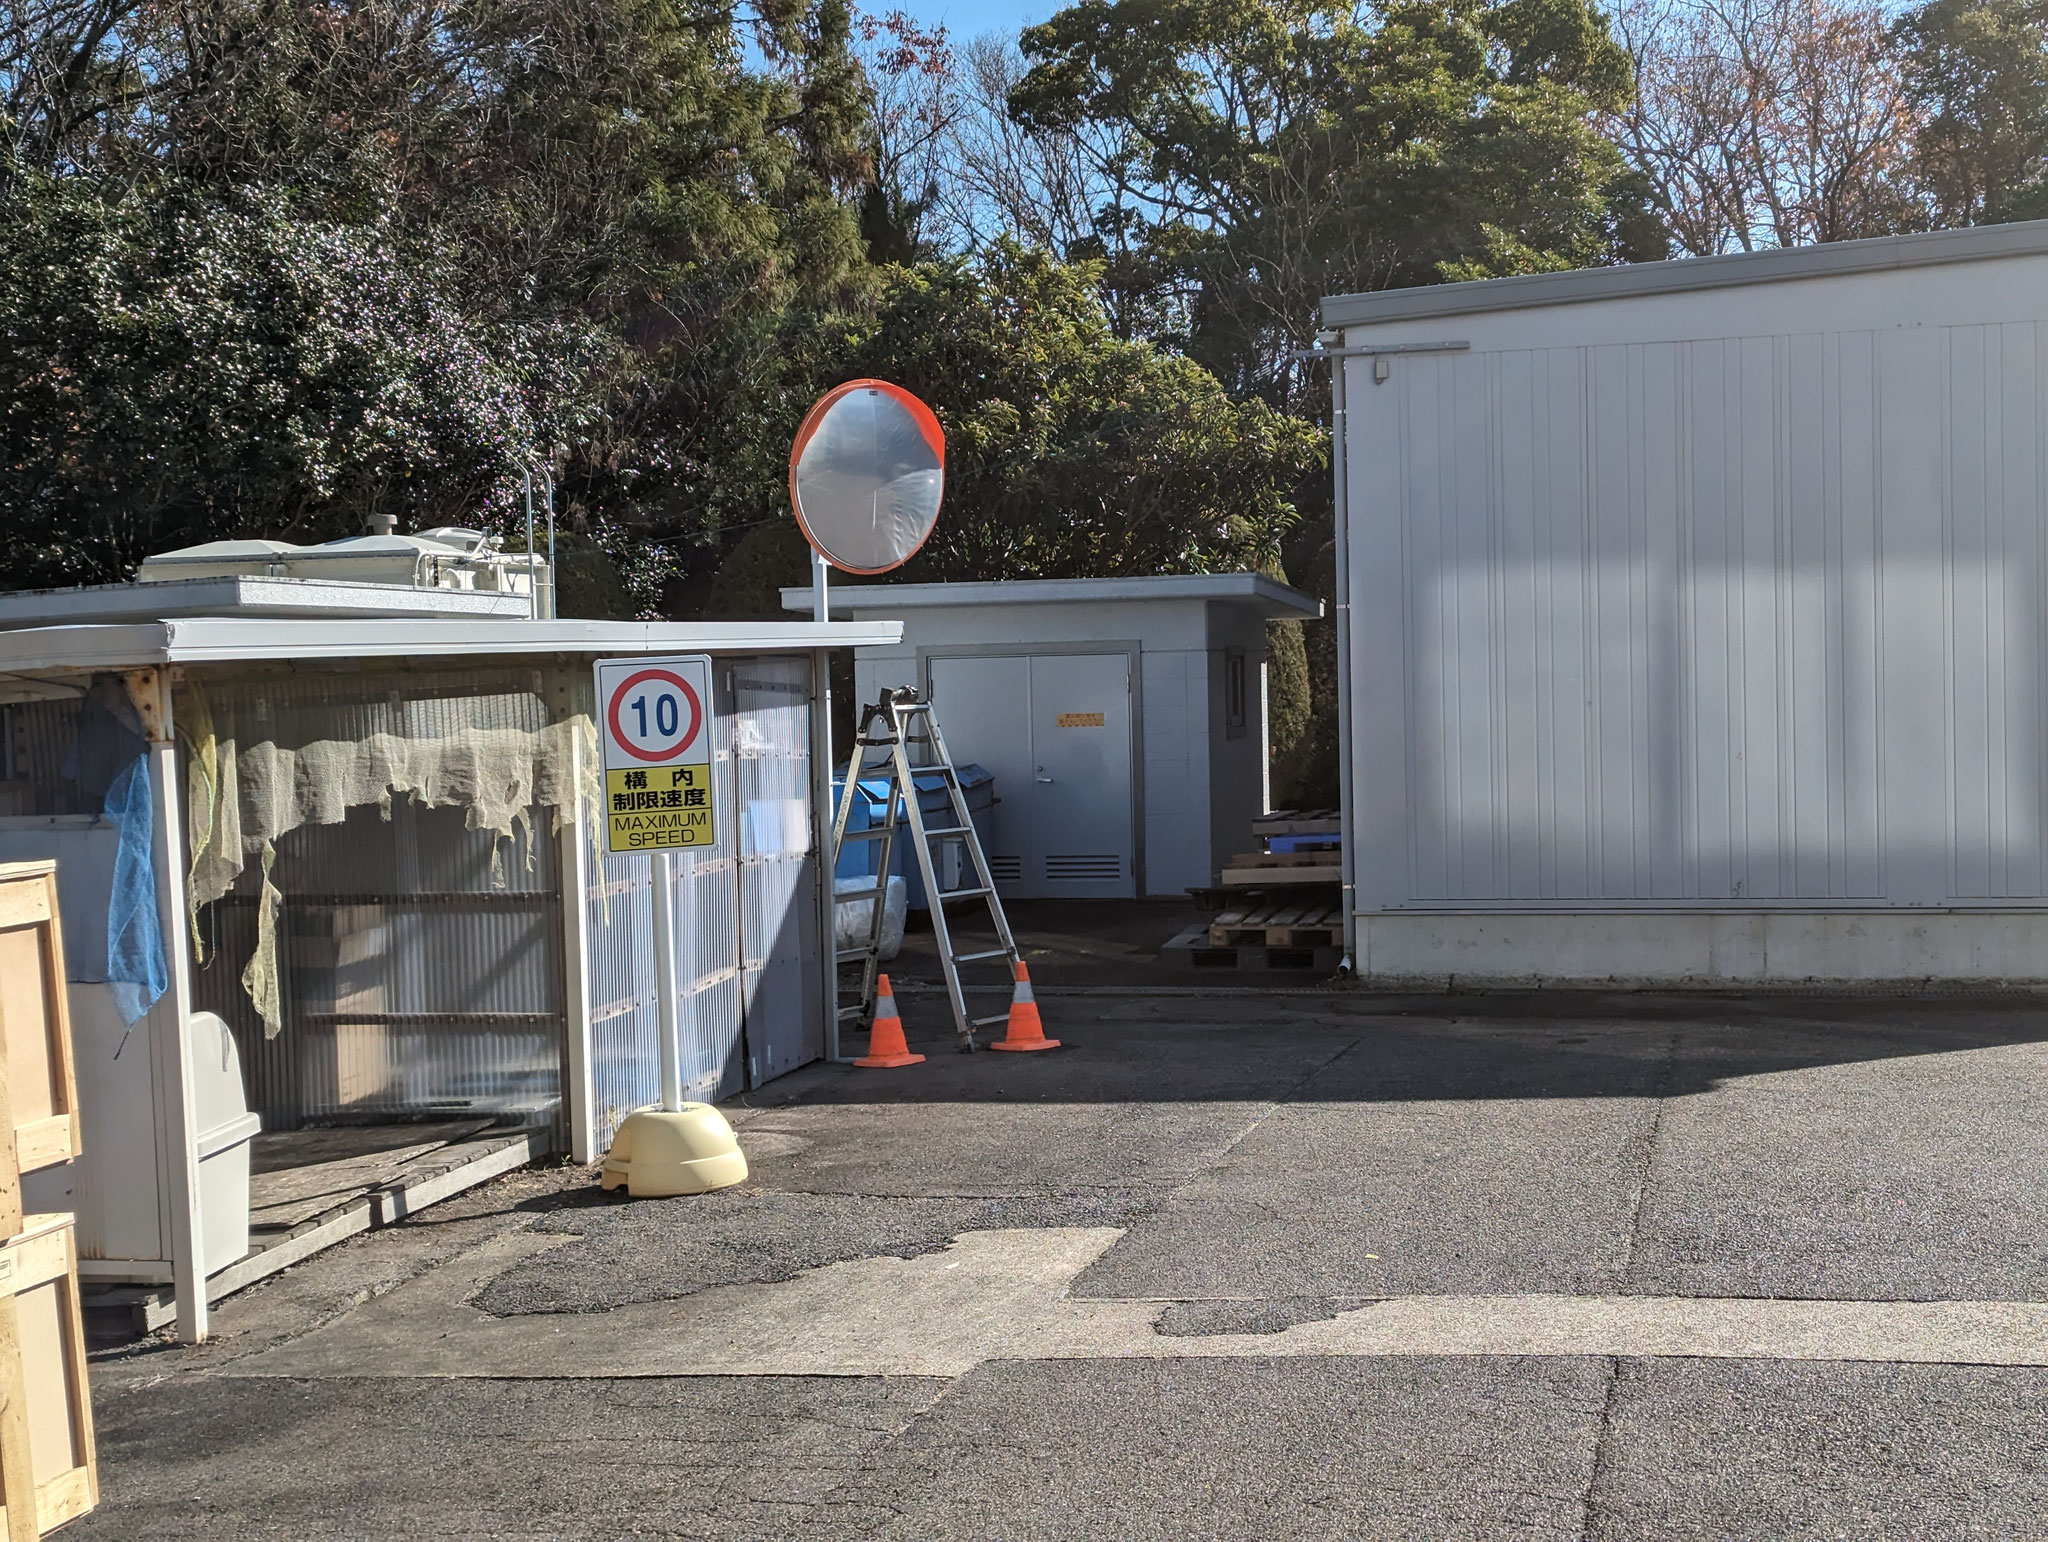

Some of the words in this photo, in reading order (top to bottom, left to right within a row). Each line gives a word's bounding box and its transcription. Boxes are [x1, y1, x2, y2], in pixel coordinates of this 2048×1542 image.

[631, 693, 679, 737] 10
[613, 788, 706, 811] 制限速度
[615, 812, 706, 831] MAXIMUM
[628, 829, 695, 846] SPEED
